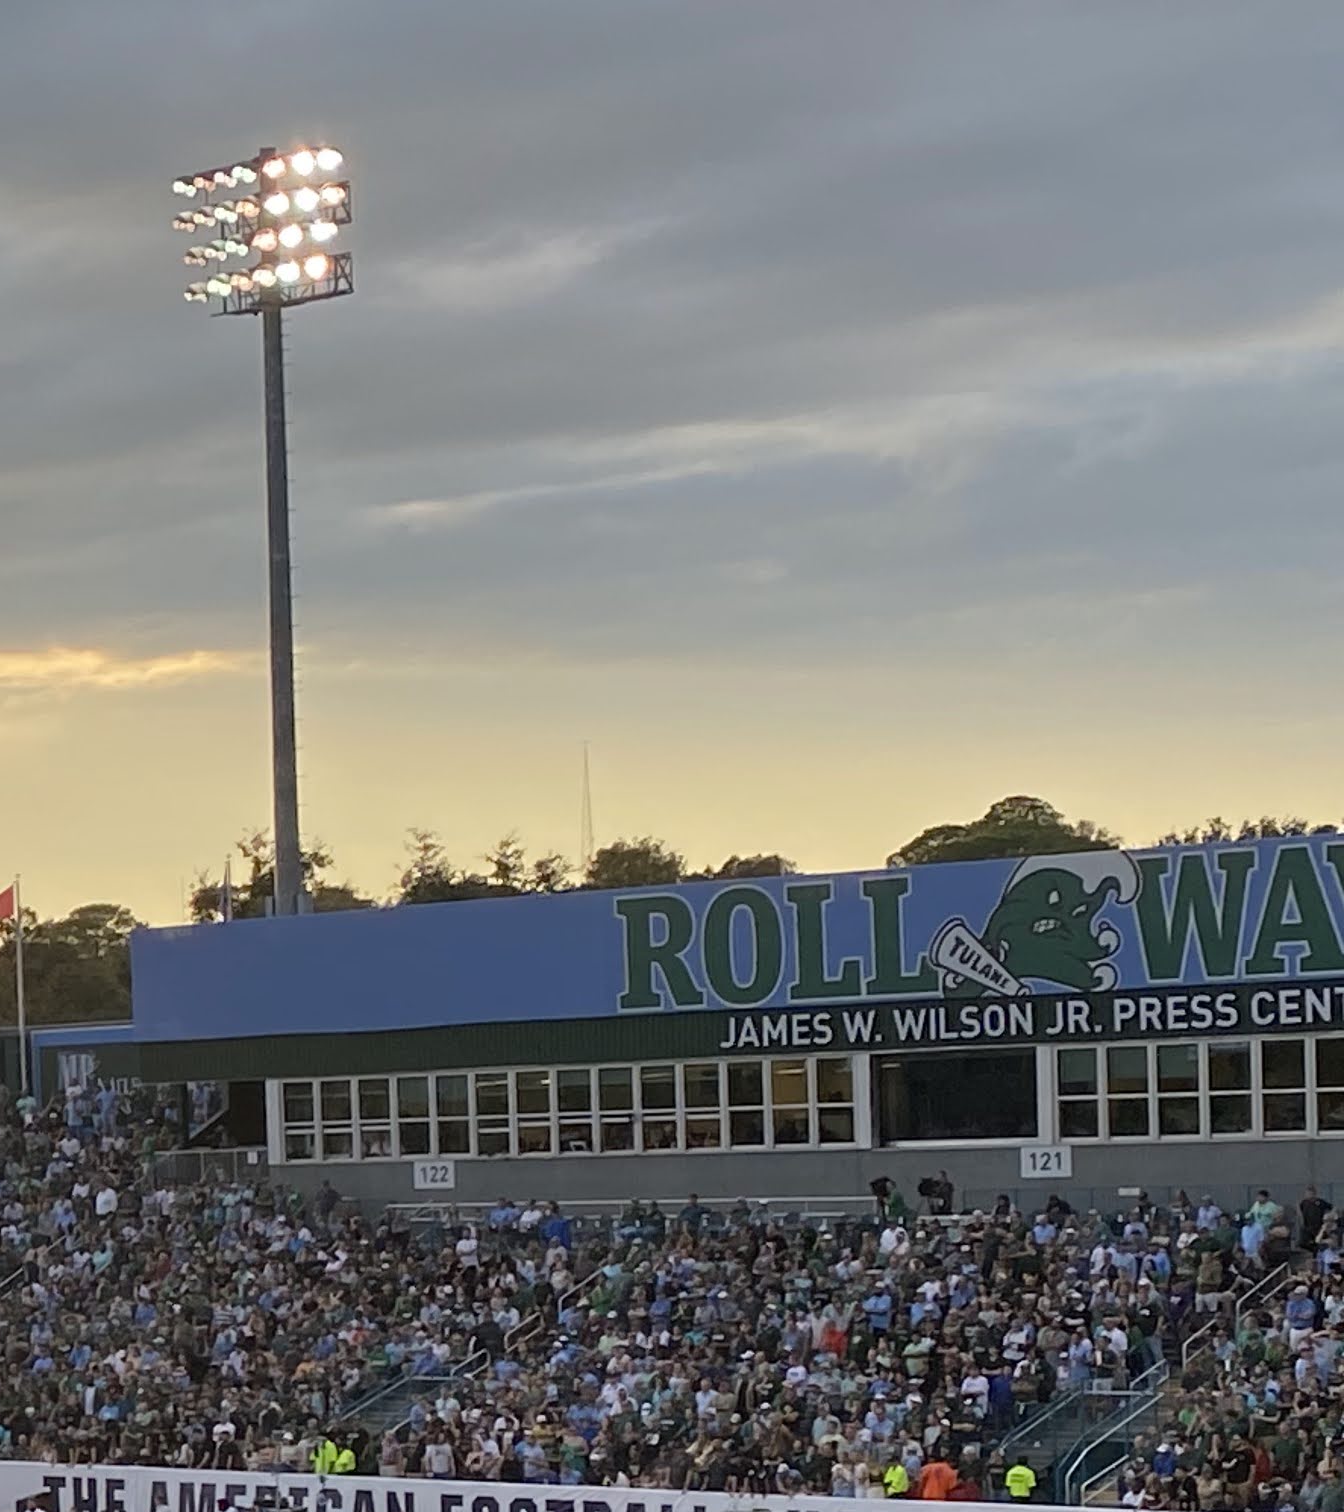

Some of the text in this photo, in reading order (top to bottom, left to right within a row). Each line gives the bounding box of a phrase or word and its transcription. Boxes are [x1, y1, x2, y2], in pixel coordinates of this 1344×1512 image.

[614, 876, 942, 1014] ROLL
[950, 936, 1011, 989] TULANE
[720, 1014, 832, 1049] JAMES
[842, 1012, 883, 1043] W.
[893, 1002, 1033, 1041] WILSON
[1045, 999, 1102, 1036] JR.
[1114, 992, 1238, 1033] PRESS
[420, 1165, 448, 1183] 122
[1029, 1152, 1062, 1171] 121
